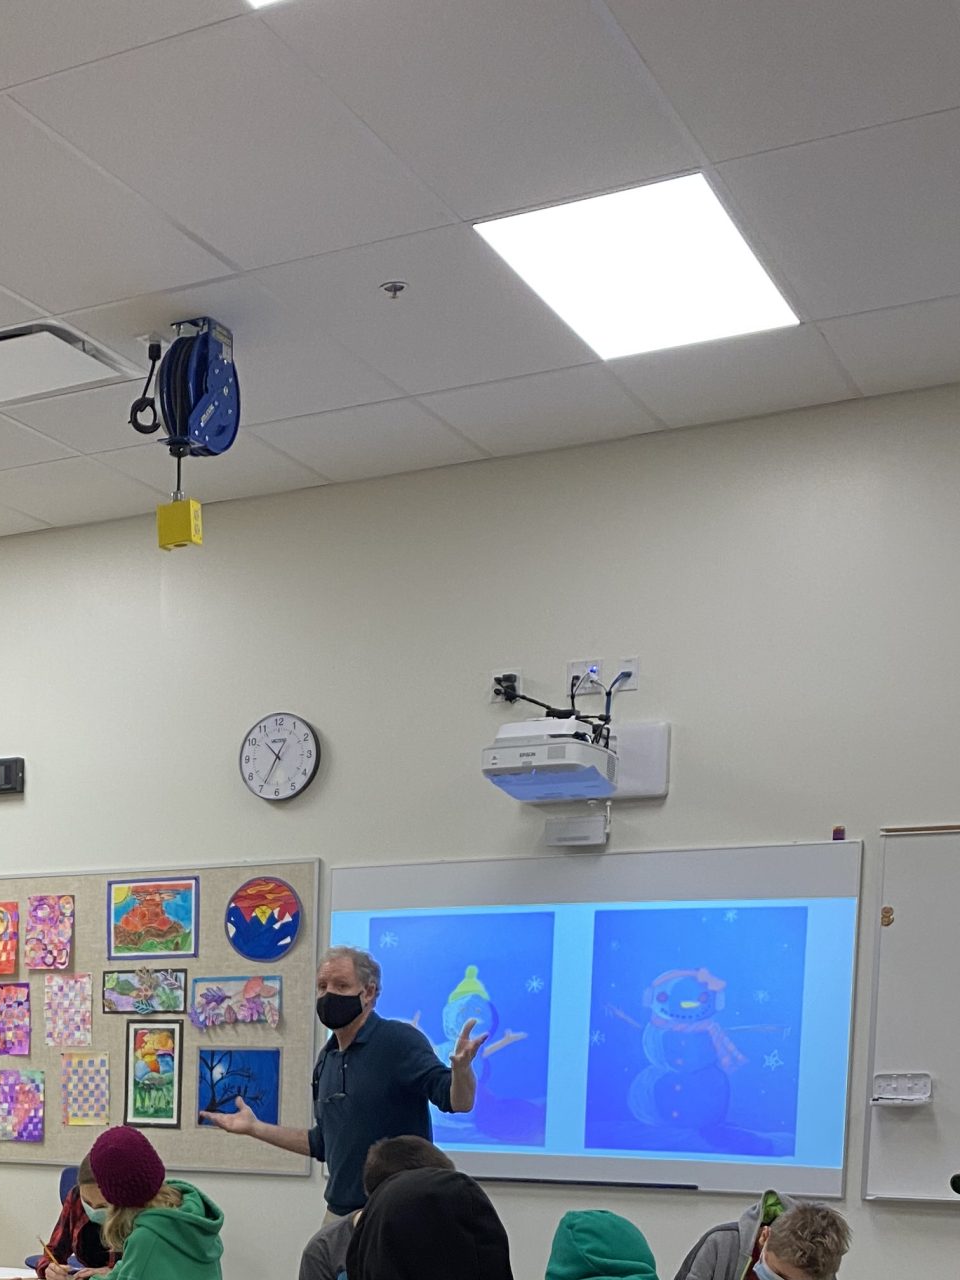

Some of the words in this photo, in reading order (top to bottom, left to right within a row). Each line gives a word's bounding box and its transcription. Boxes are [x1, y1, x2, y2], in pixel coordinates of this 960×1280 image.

[274, 717, 284, 726] 12
[292, 721, 296, 730] 1
[259, 725, 267, 733] 11
[248, 737, 257, 746] 10
[303, 733, 309, 741] 2
[306, 750, 312, 758] 3
[244, 755, 250, 764] 9
[248, 772, 254, 781] 8
[301, 768, 307, 776] 4
[258, 784, 264, 793] 7
[290, 782, 296, 791] 5
[274, 788, 280, 797] 6
